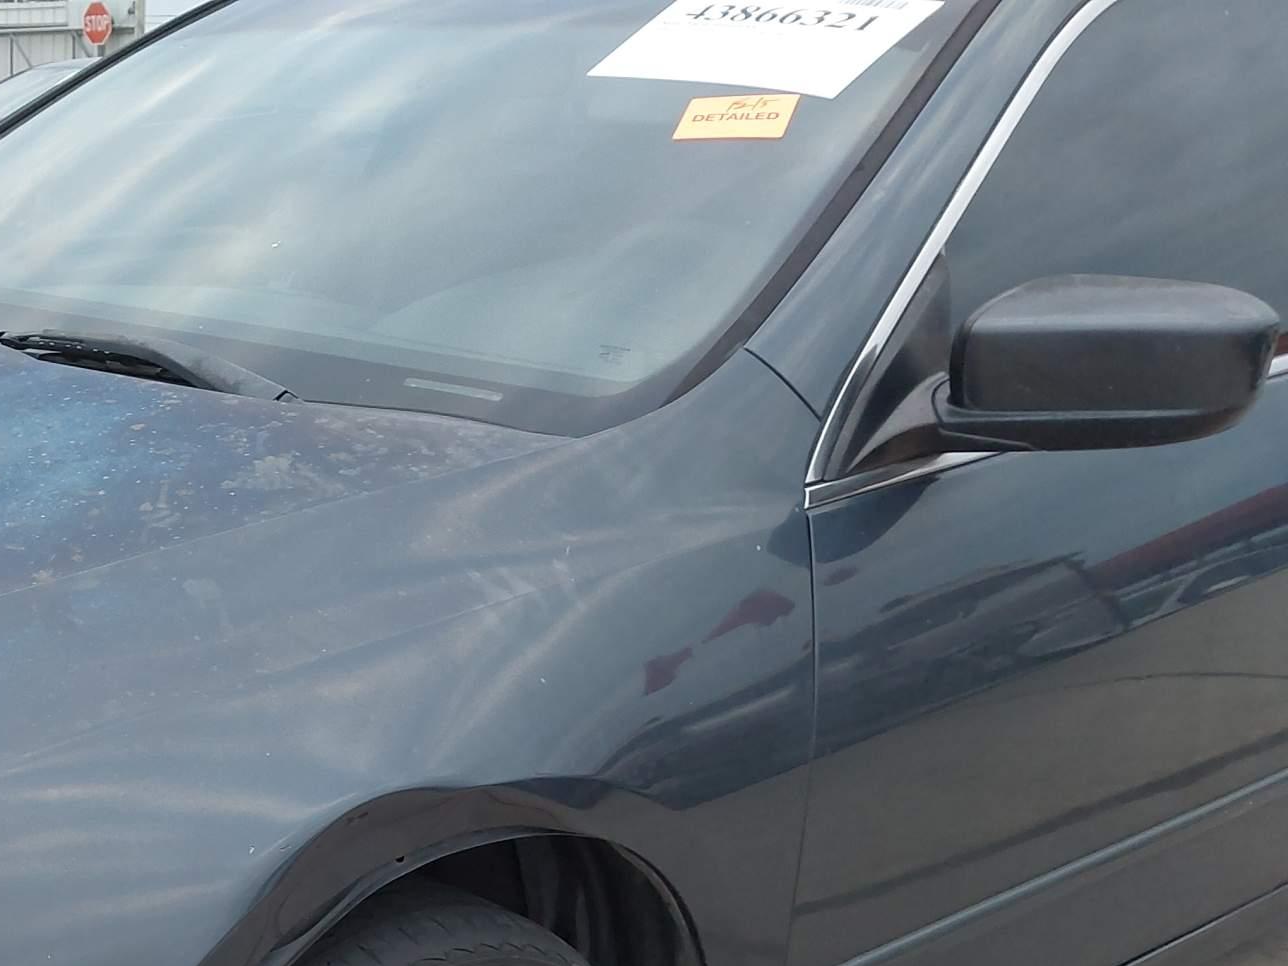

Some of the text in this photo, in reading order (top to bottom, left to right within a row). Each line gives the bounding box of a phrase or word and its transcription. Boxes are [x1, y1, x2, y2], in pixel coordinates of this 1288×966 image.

[85, 14, 111, 32] STOP
[686, 4, 880, 31] 43866321
[691, 111, 780, 122] DETAILED
